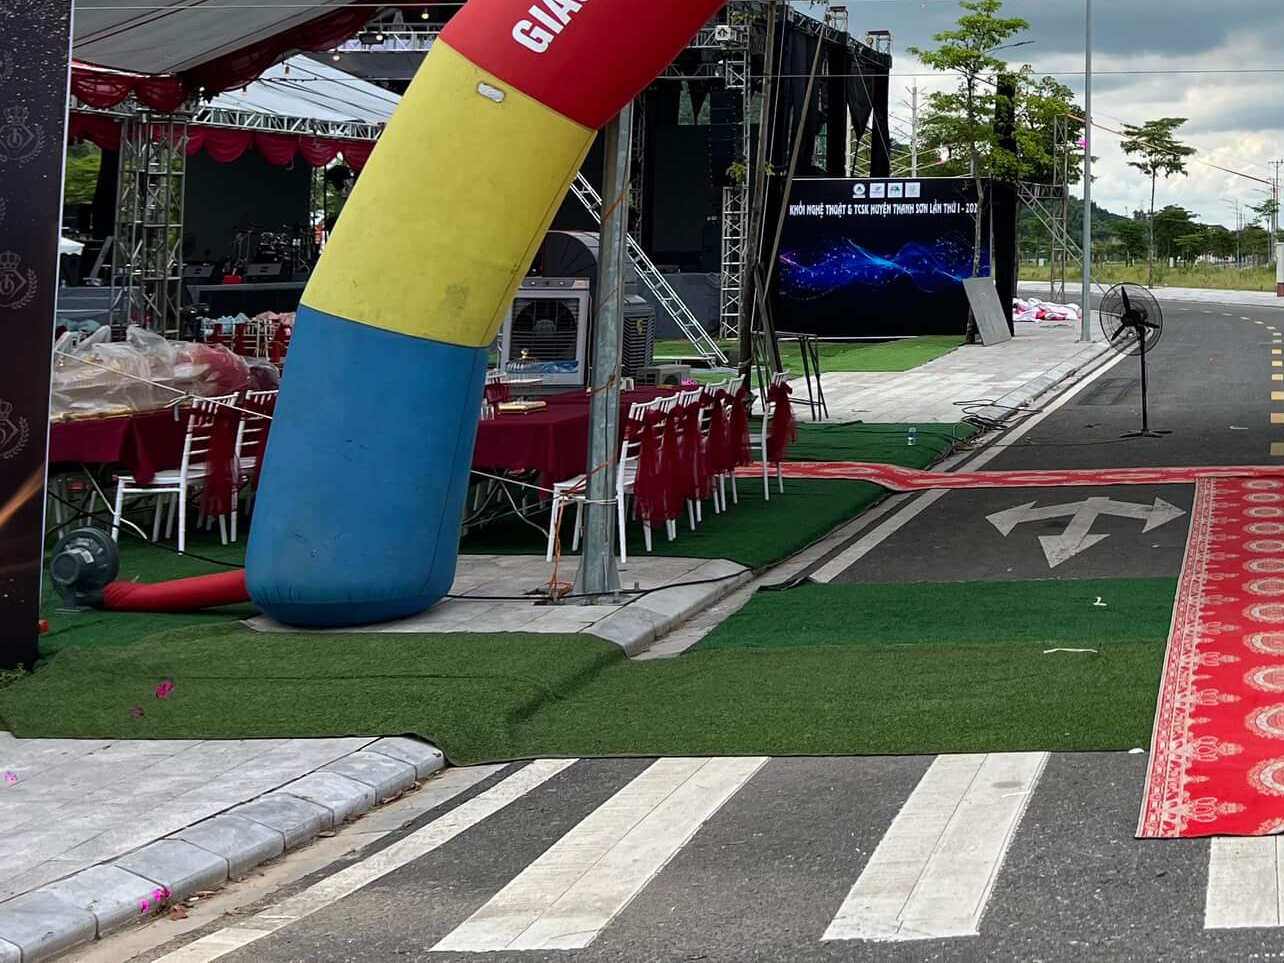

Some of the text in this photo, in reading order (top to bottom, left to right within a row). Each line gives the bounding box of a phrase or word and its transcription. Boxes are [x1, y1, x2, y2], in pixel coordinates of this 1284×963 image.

[854, 204, 869, 215] TCSK
[870, 202, 892, 218] HUYỆN
[892, 203, 914, 215] THANH
[915, 203, 928, 214] SƠN
[965, 203, 978, 214] 202
